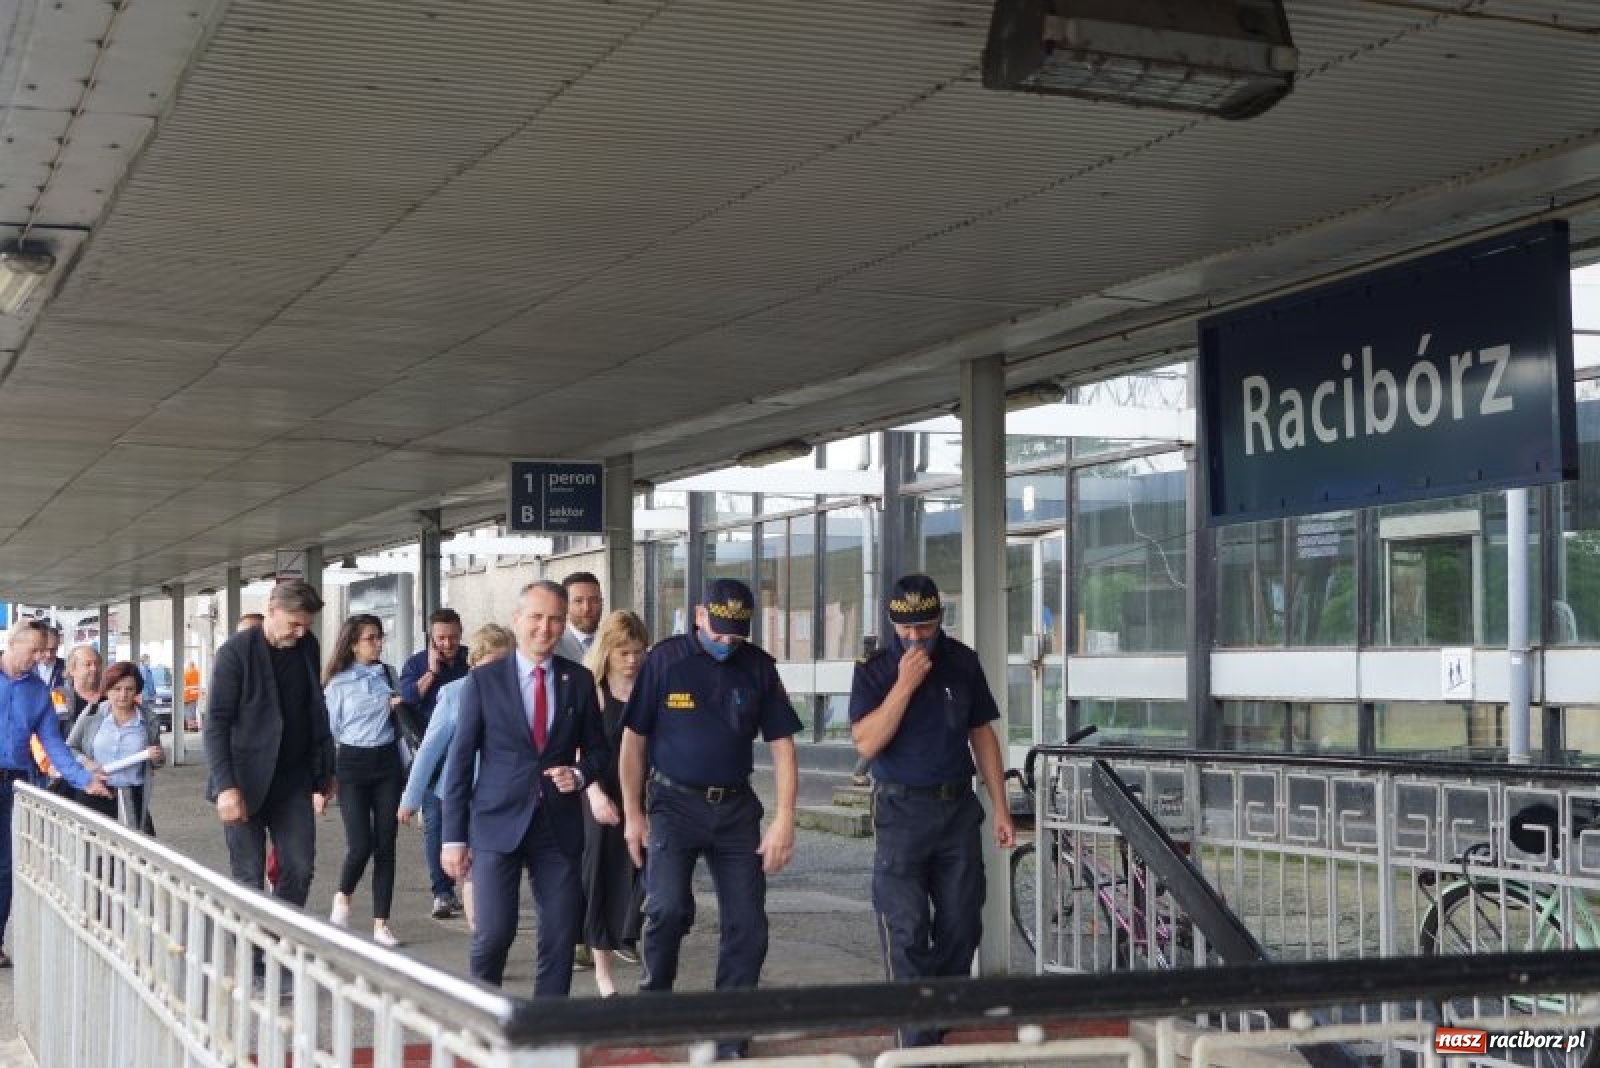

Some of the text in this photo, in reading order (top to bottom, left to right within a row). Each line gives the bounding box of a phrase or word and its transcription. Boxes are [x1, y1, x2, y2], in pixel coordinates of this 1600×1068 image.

[1242, 333, 1513, 456] Racibórz
[523, 472, 596, 493] 1 peron
[521, 505, 534, 523] B
[549, 506, 584, 517] sektor
